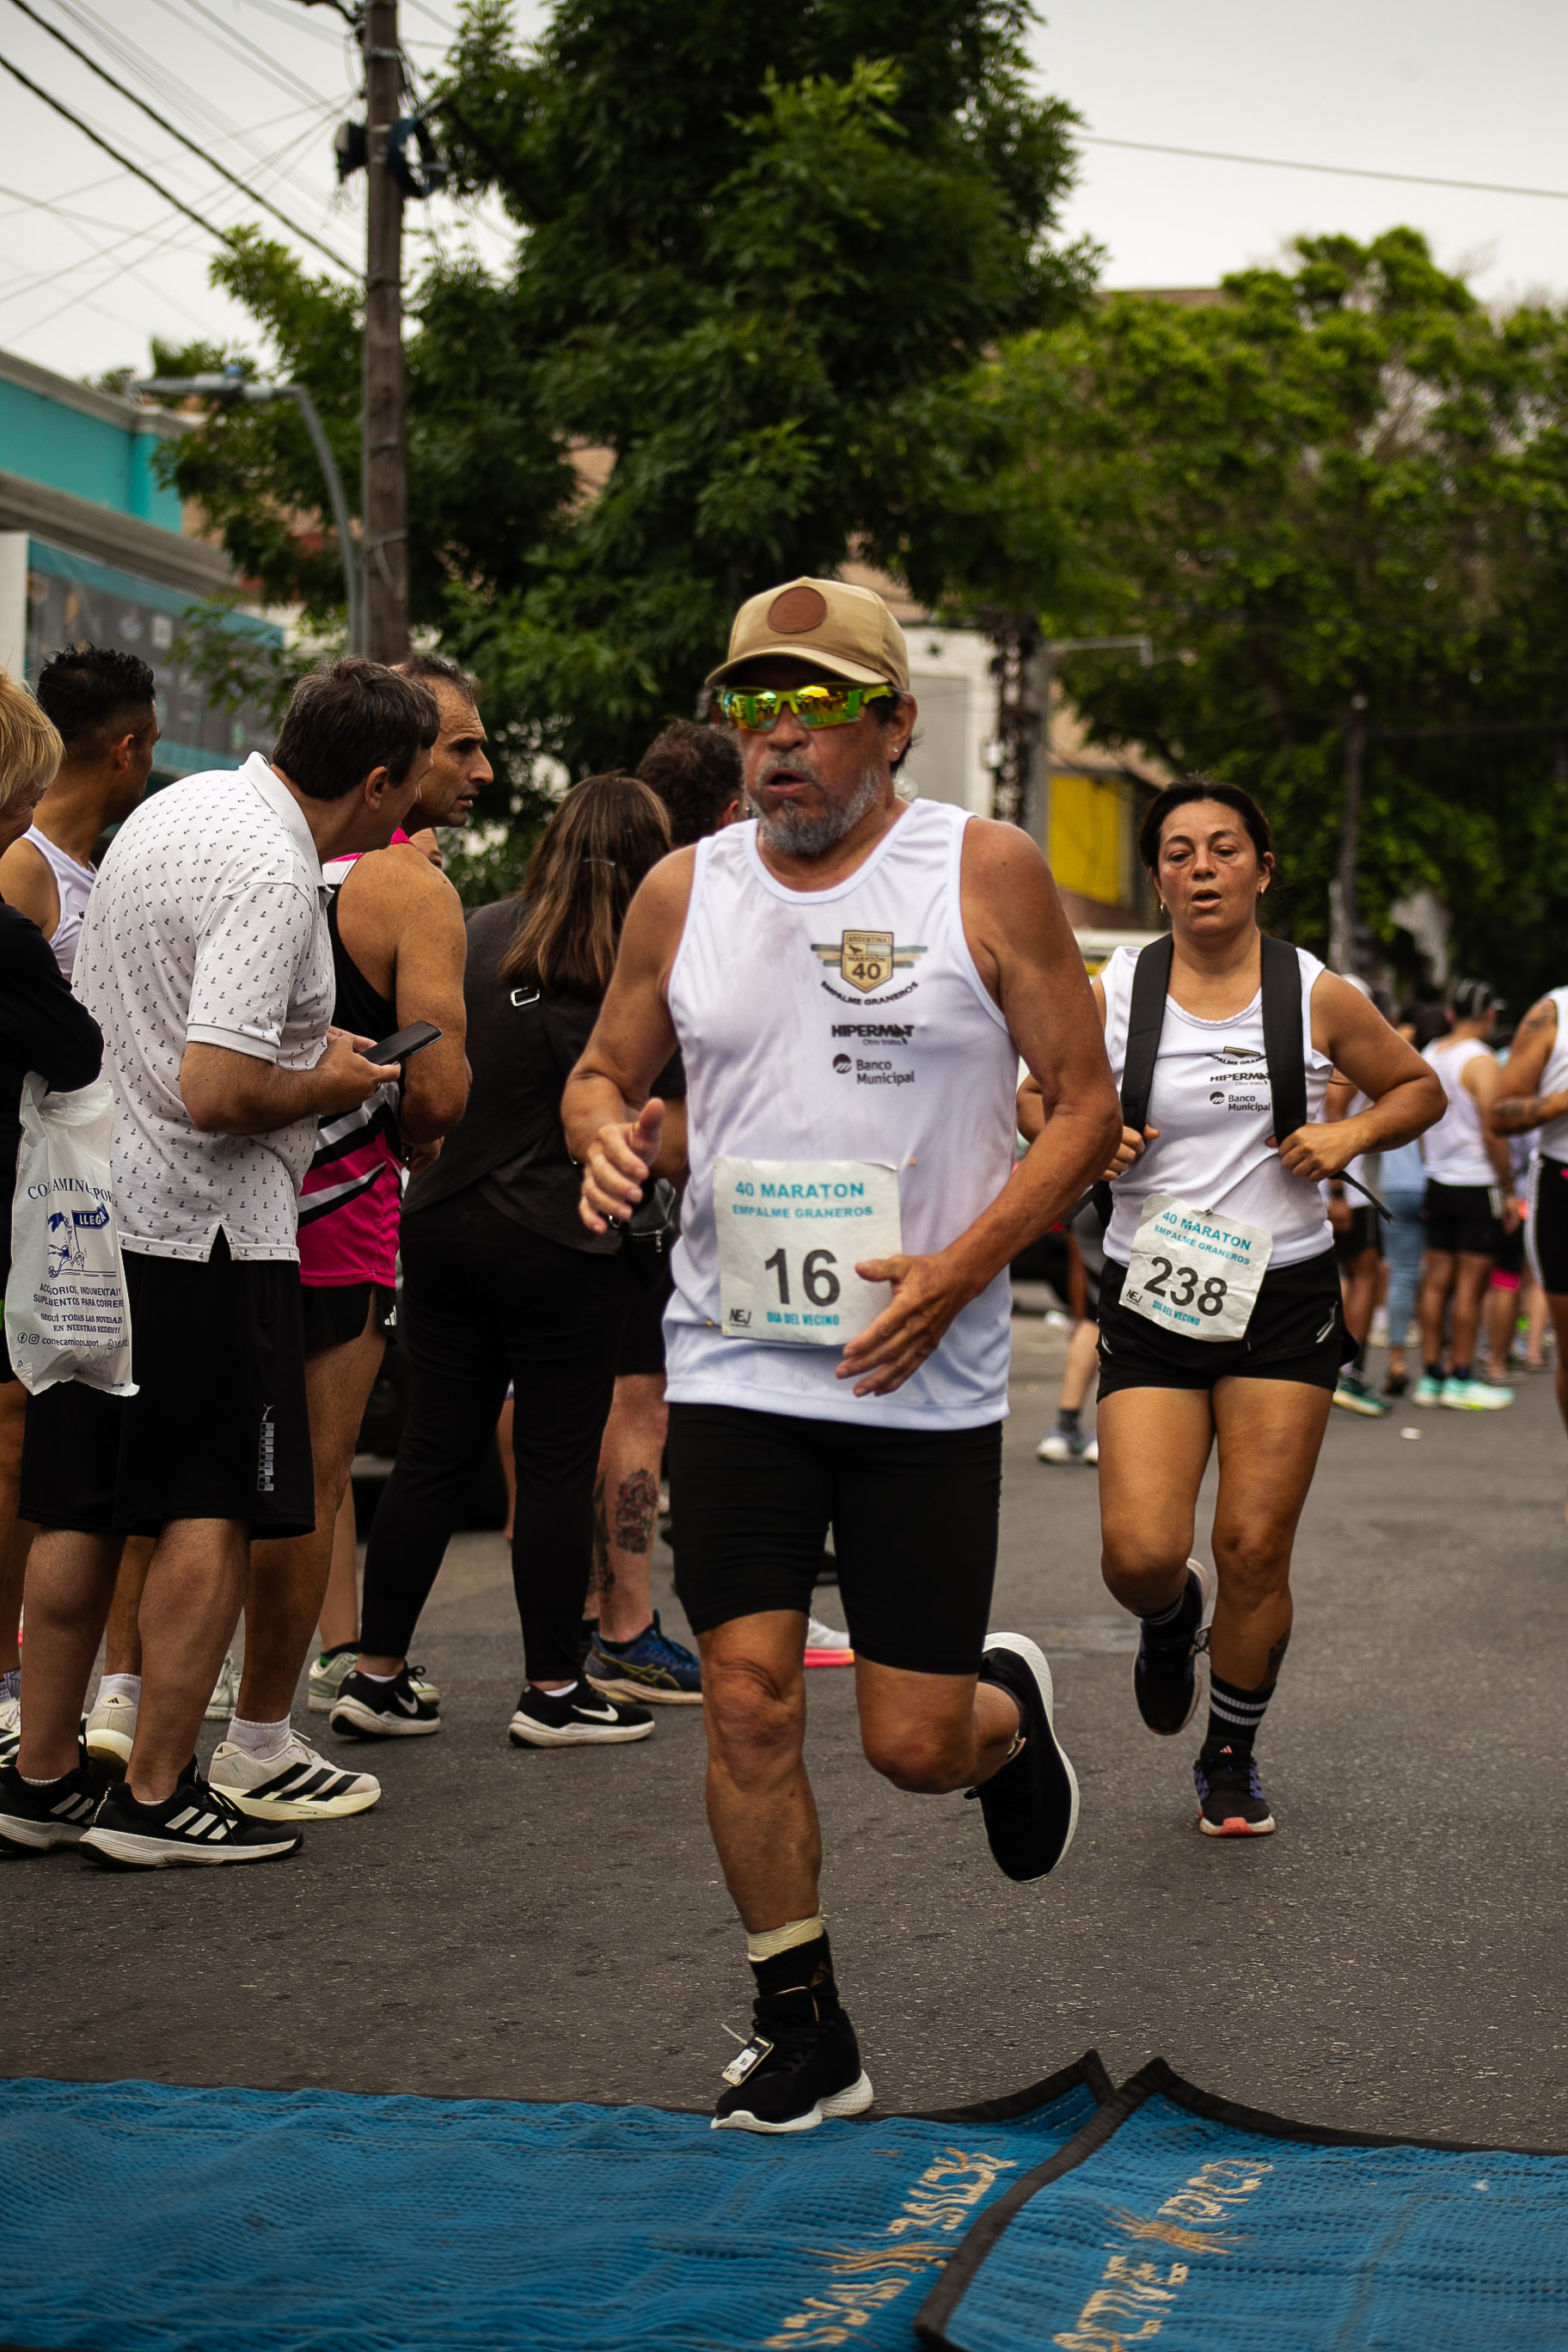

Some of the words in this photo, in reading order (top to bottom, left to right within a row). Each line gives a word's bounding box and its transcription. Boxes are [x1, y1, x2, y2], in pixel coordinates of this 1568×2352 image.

[852, 963, 881, 980] 40
[821, 981, 862, 1006] EMPALME
[864, 981, 918, 1006] GRANEROS
[856, 1059, 892, 1071] Banco
[856, 1071, 915, 1087] Municipal
[1228, 1103, 1271, 1112] Municipal
[735, 1181, 755, 1197] 40
[761, 1182, 865, 1198] MARATON
[79, 1211, 107, 1225] LLEGA
[732, 1204, 790, 1218] EMPALME
[795, 1205, 873, 1219] GRANEROS
[1162, 1211, 1178, 1225] 40
[1180, 1218, 1252, 1251] MARATON
[1154, 1224, 1196, 1247] EMPALME
[1198, 1241, 1250, 1265] GRANEROS
[764, 1247, 841, 1307] 16
[1143, 1256, 1228, 1316] 238
[1125, 1289, 1142, 1303] NEJ
[729, 1308, 751, 1325] NEJ
[767, 1311, 781, 1324] DIA
[784, 1313, 799, 1325] DEL
[802, 1314, 840, 1326] VECINO
[1152, 1300, 1162, 1311] DIA
[1162, 1305, 1173, 1316] DEL
[1173, 1310, 1201, 1326] VECINO
[257, 1422, 274, 1491] PUMA
